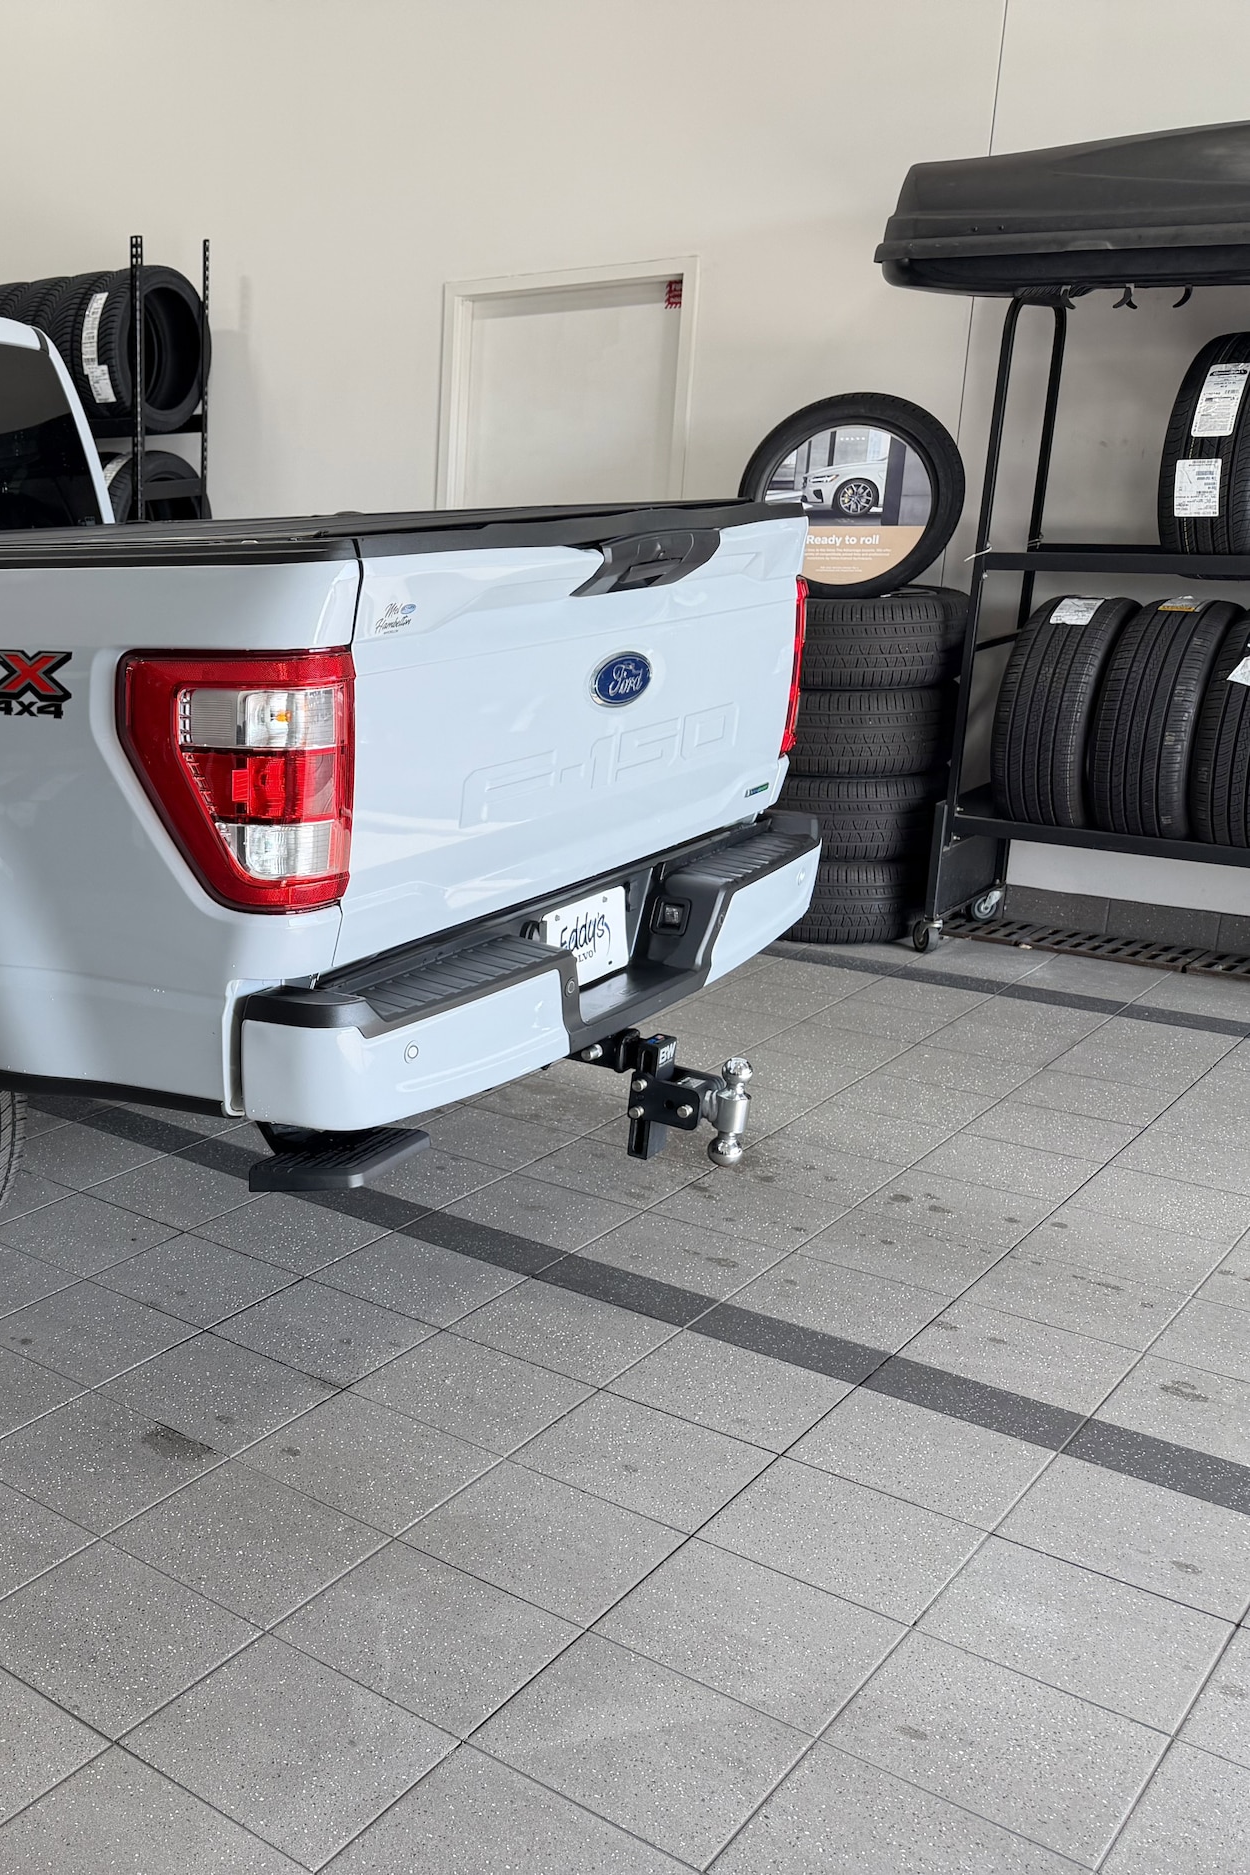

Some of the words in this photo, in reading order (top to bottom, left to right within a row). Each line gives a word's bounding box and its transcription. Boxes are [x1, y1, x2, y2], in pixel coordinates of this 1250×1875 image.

[806, 534, 842, 546] Ready
[845, 535, 857, 545] to
[860, 534, 880, 545] roll
[608, 663, 643, 697] Ford
[458, 701, 739, 829] F-150
[577, 949, 595, 963] LVO
